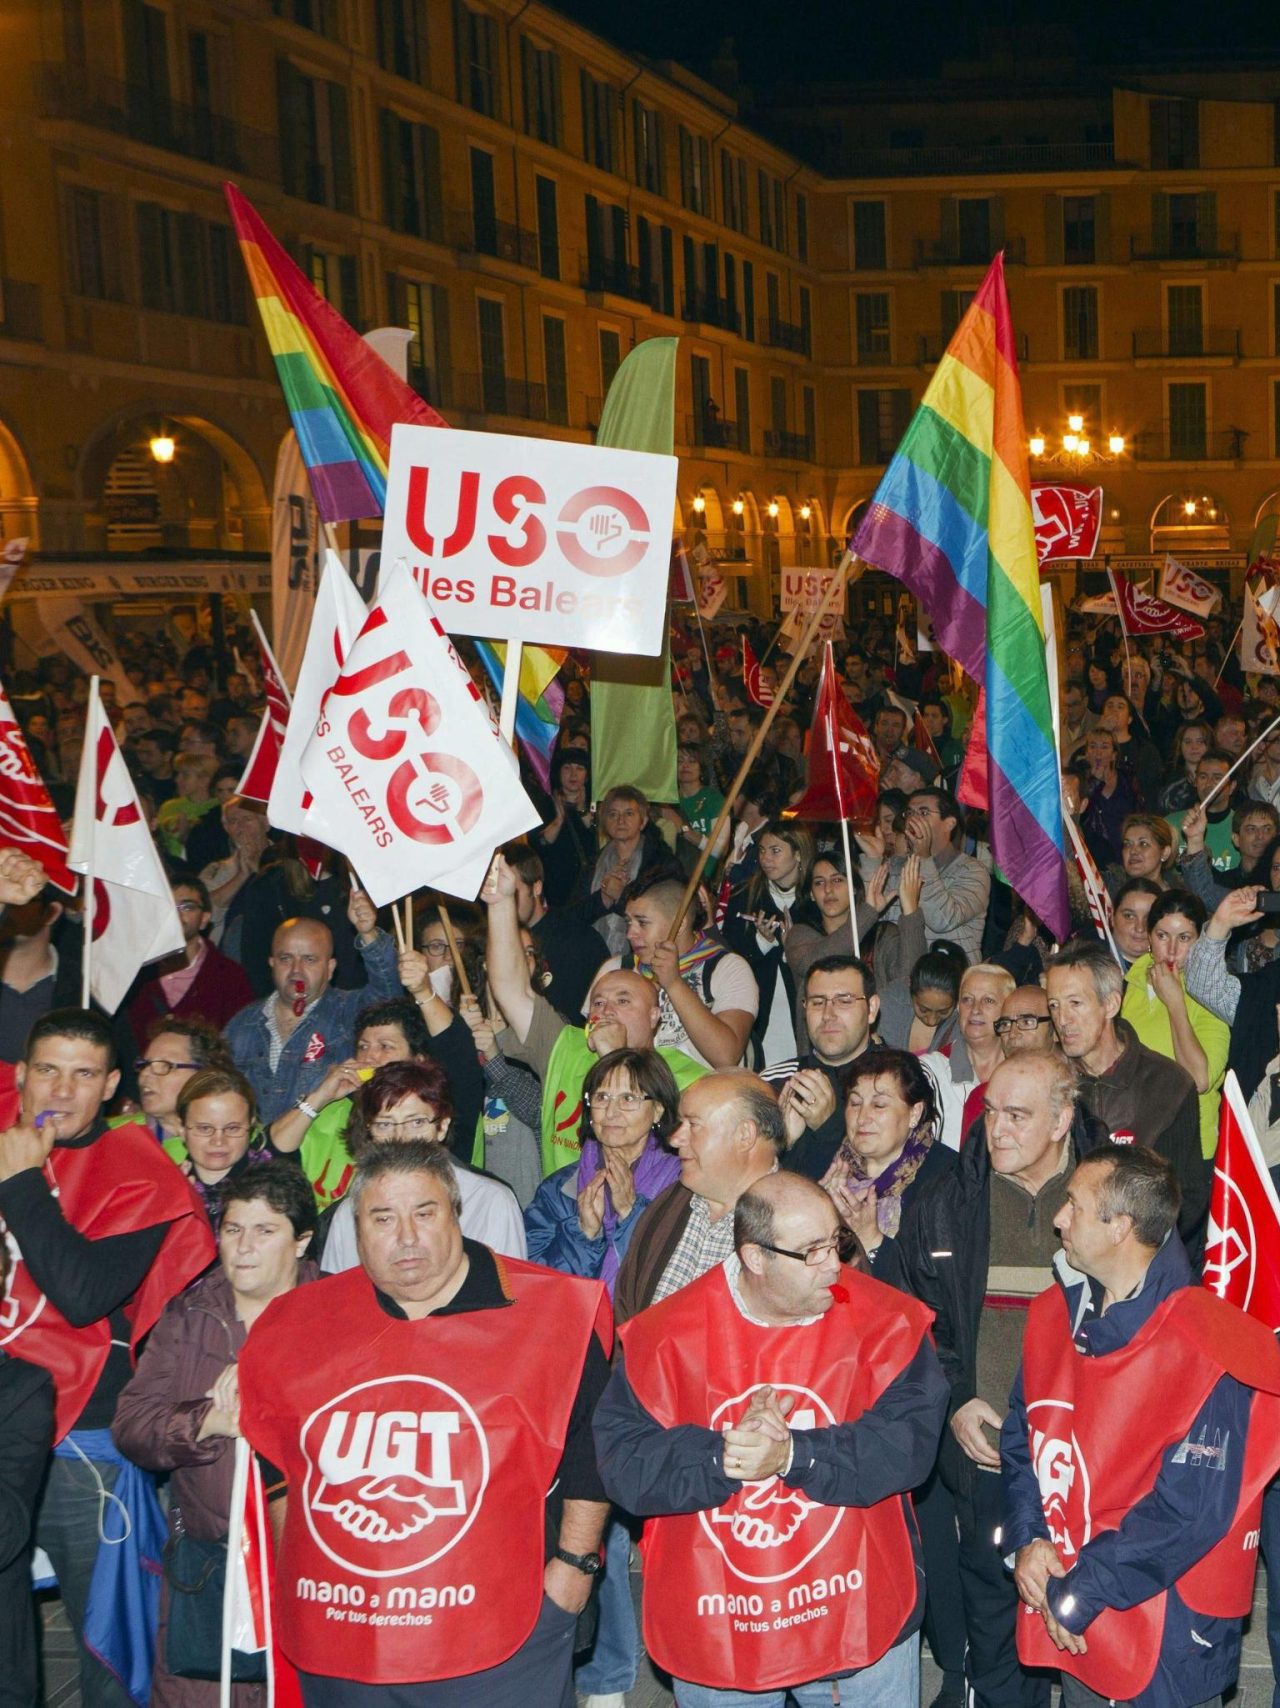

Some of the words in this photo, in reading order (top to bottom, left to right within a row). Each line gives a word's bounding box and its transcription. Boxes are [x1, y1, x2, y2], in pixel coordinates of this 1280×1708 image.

[405, 466, 651, 578] USO
[413, 567, 475, 603] lles
[331, 606, 484, 846] USO
[326, 746, 394, 848] BALEARS
[318, 1411, 461, 1486] UGT
[297, 1577, 366, 1607] mano
[369, 1594, 380, 1608] a
[386, 1584, 476, 1609] mano
[697, 1593, 764, 1616] mano
[770, 1599, 782, 1613] a
[788, 1569, 863, 1610] mano
[326, 1607, 346, 1620] Por
[347, 1608, 368, 1624] tus
[369, 1613, 433, 1627] derechos
[733, 1619, 749, 1632] Por
[750, 1620, 770, 1633] tus
[773, 1604, 829, 1630] derechos
